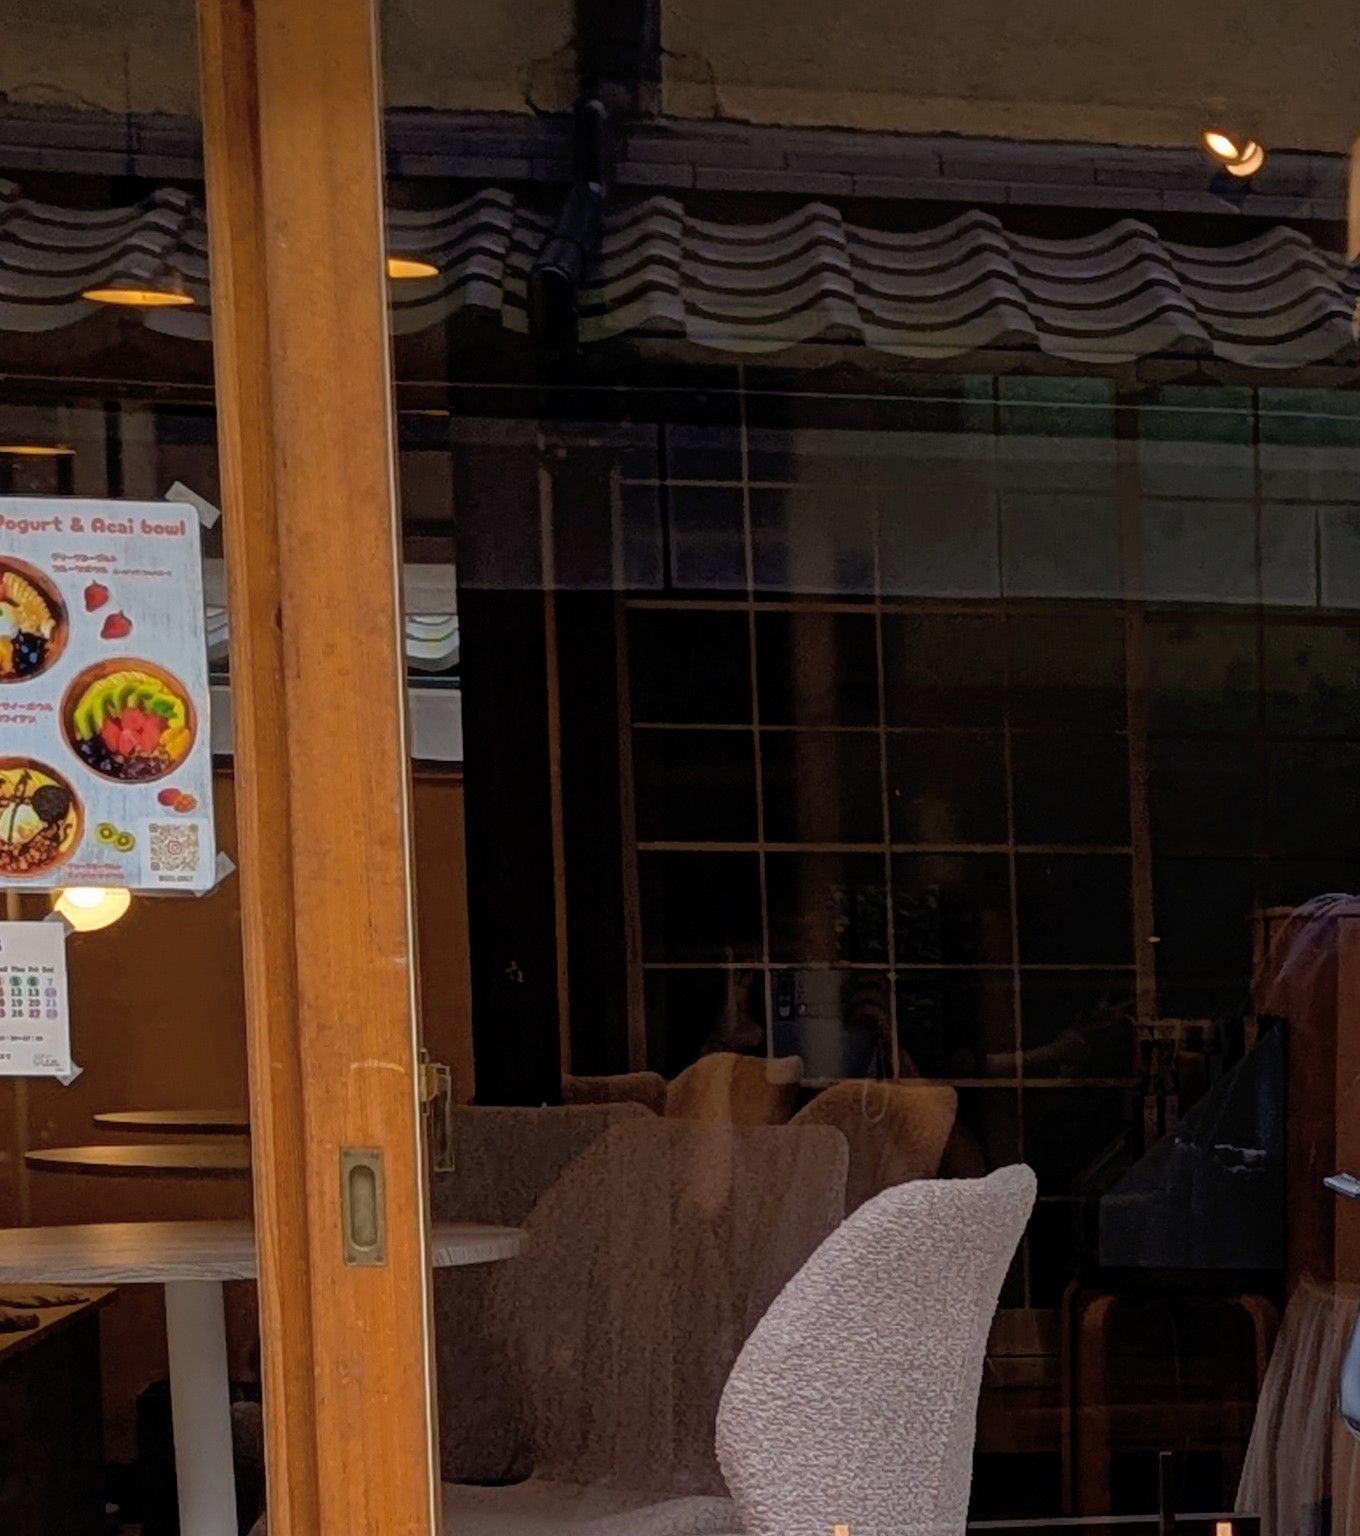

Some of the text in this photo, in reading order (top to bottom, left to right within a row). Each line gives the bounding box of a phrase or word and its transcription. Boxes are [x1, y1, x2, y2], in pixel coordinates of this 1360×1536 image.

[69, 517, 85, 533] &
[91, 518, 134, 534] Acai
[140, 519, 187, 536] bowl
